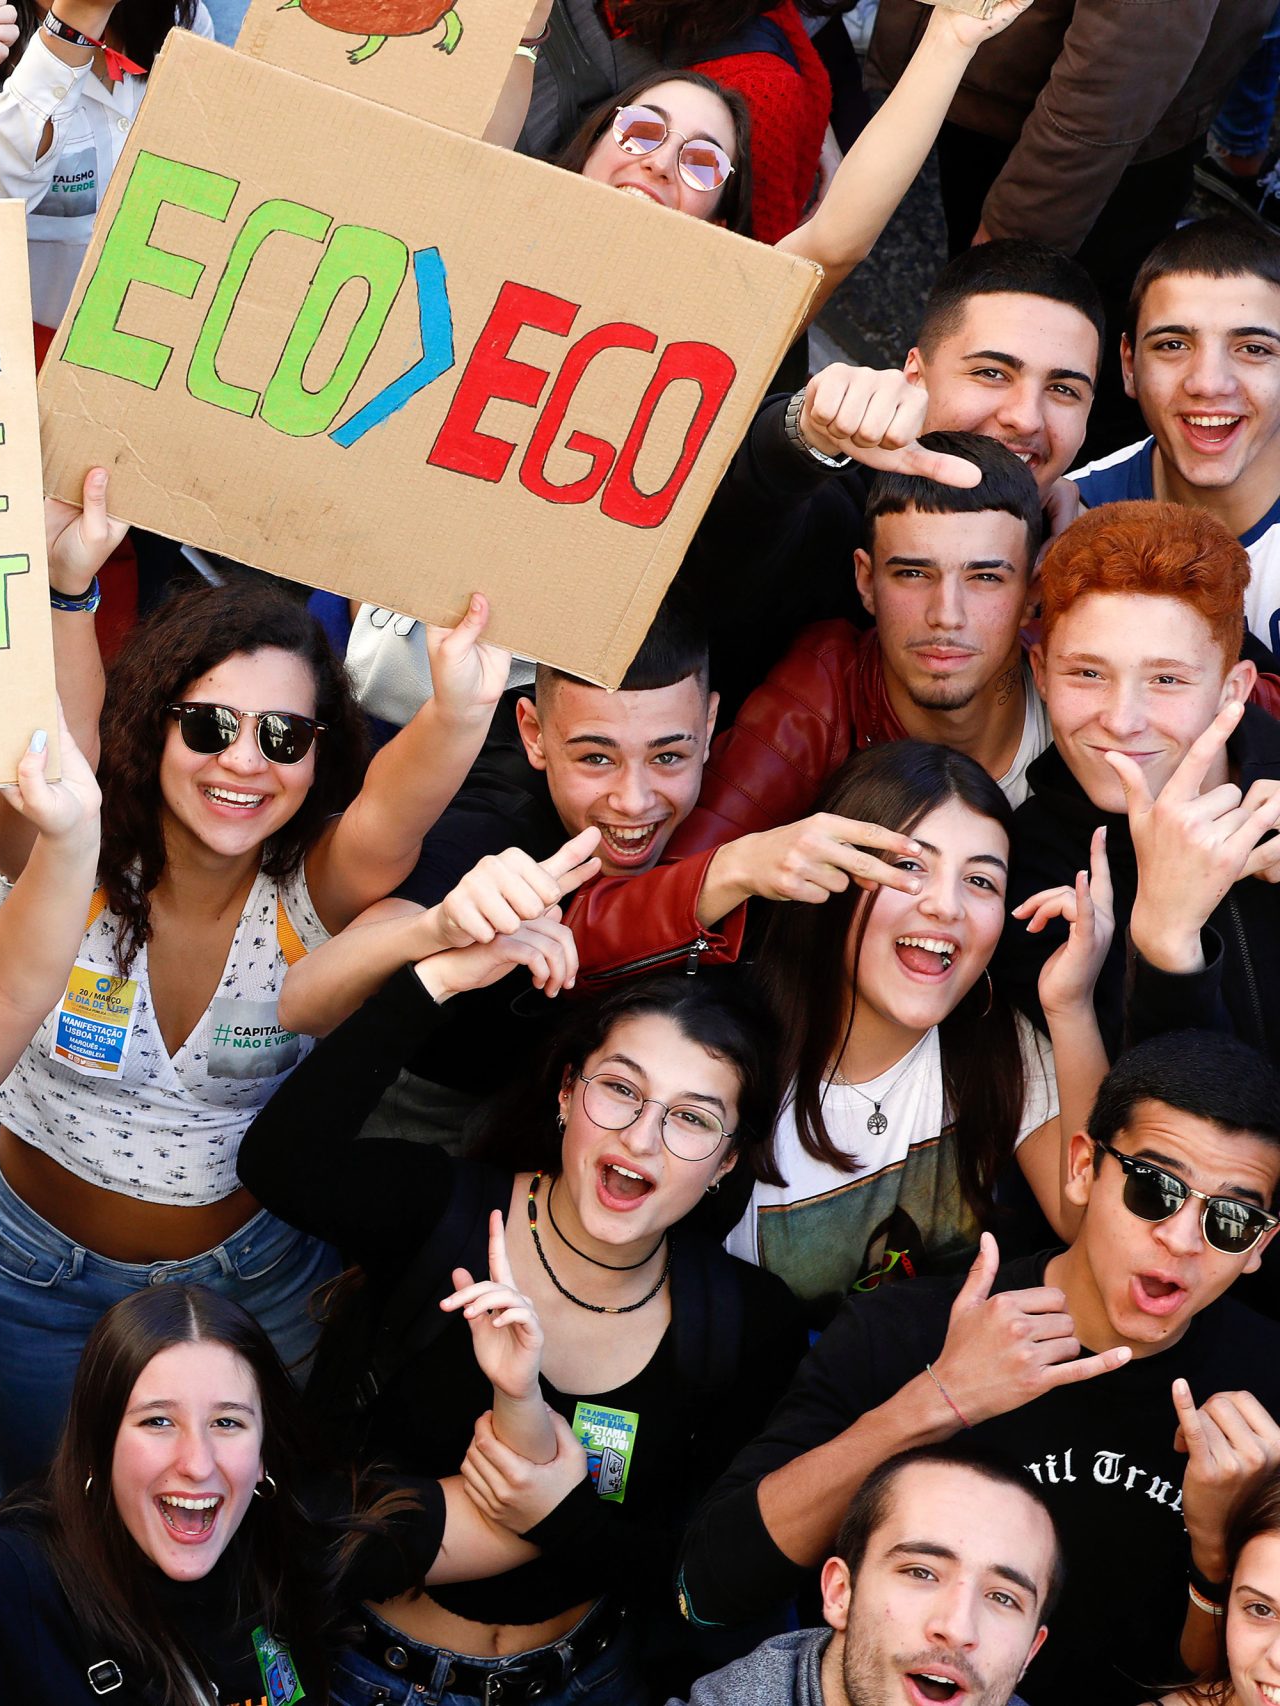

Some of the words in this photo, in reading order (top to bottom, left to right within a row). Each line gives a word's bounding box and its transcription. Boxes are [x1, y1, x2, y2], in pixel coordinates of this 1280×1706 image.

[62, 180, 95, 193] VERDE
[64, 1025, 92, 1040] LISBOA
[94, 1035, 116, 1046] 10:30
[233, 1036, 261, 1048] NÃO
